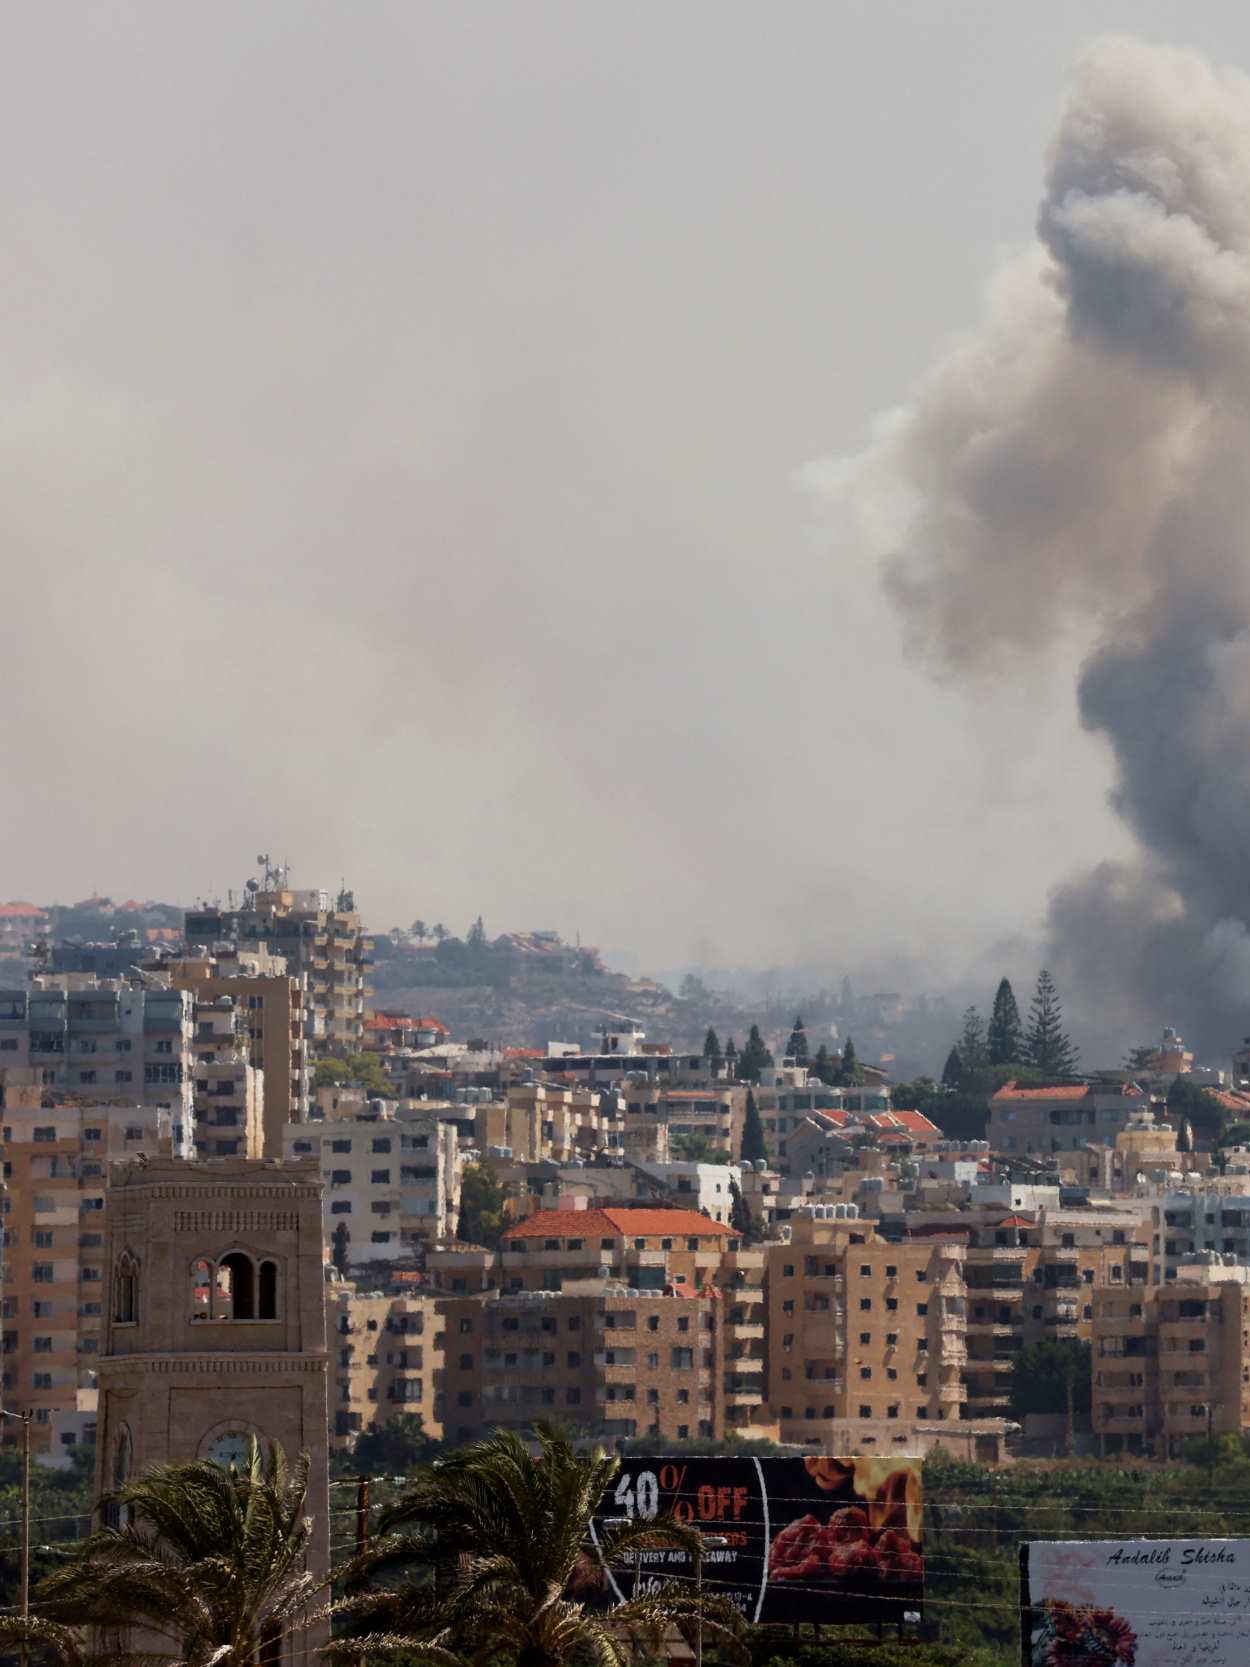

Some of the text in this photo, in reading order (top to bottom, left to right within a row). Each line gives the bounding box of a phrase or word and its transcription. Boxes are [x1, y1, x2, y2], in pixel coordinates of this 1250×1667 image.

[698, 1484, 748, 1521] OFF
[667, 1551, 686, 1563] AND
[1106, 1546, 1236, 1567] Andalib Shisha
